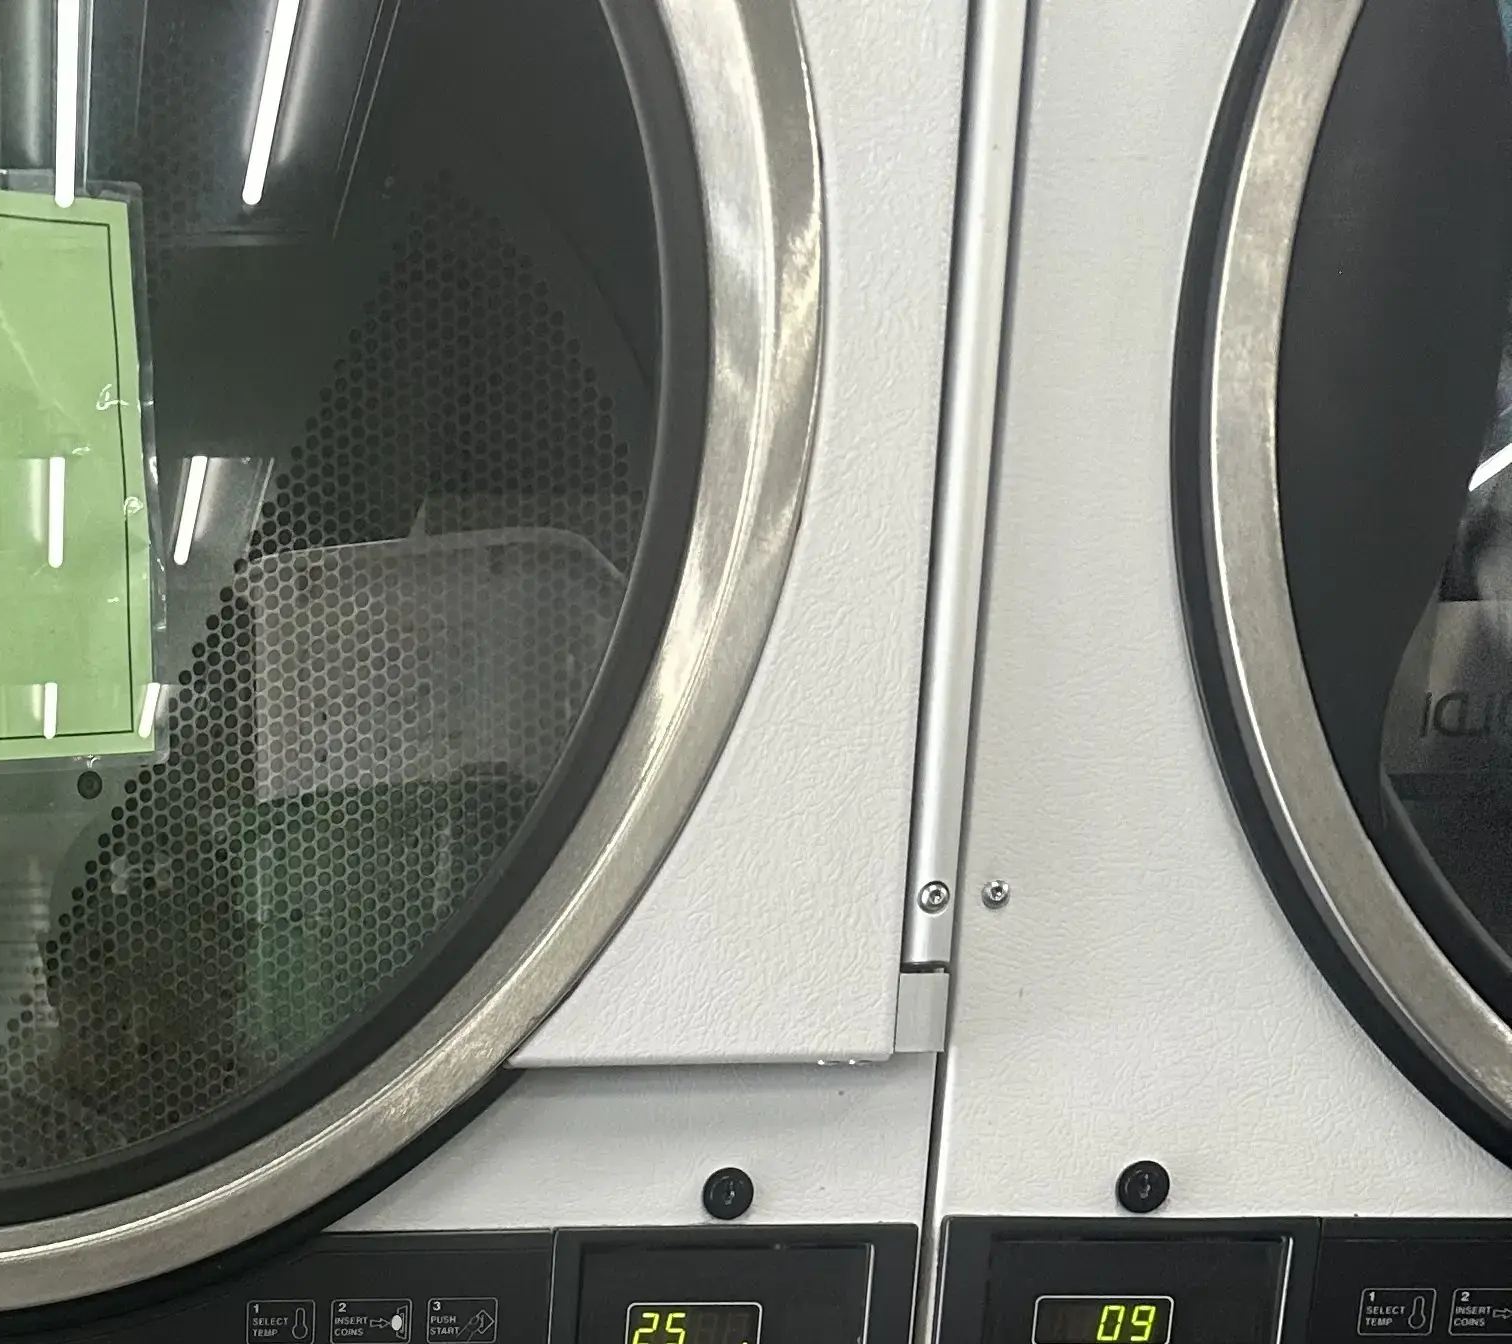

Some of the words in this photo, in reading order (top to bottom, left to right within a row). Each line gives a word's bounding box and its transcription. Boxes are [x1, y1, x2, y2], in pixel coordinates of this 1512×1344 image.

[1369, 1291, 1376, 1302] 1
[1460, 1291, 1470, 1302] 2
[338, 1303, 347, 1312] 2
[432, 1301, 441, 1311] 3
[1366, 1306, 1405, 1315] SELECT
[1455, 1306, 1491, 1315] INSERT
[252, 1317, 289, 1326] SELECT
[334, 1317, 368, 1325] INSERT
[430, 1316, 457, 1324] PUSH
[1096, 1305, 1157, 1341] 09
[1365, 1317, 1393, 1326] TEMP
[1453, 1317, 1486, 1326] COINS
[252, 1328, 278, 1336] TEMP
[334, 1328, 364, 1336] COINS
[430, 1326, 460, 1336] START
